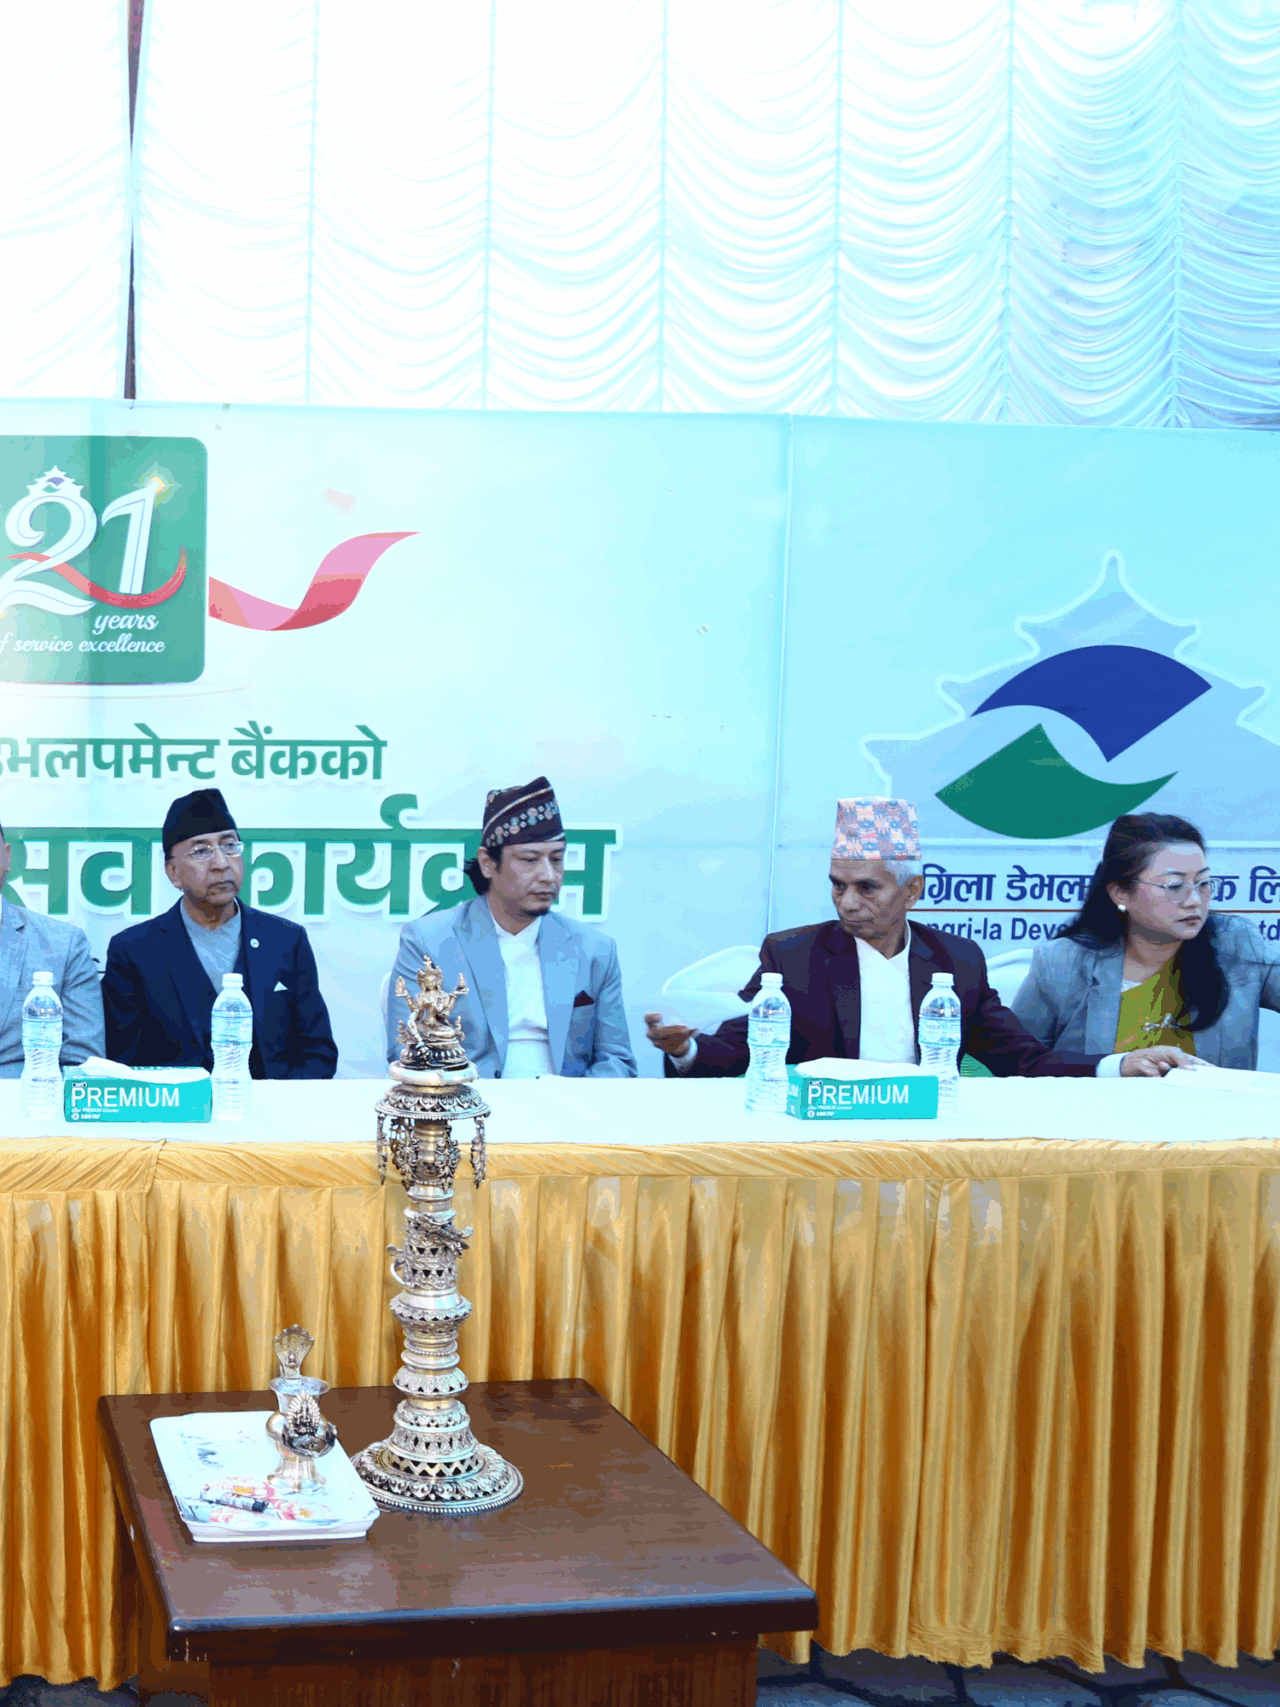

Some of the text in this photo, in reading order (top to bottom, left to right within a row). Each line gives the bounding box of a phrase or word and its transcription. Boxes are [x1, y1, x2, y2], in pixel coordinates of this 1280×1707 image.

[92, 613, 160, 635] years
[13, 635, 74, 653] service
[78, 633, 166, 653] excellence
[228, 720, 388, 780] बैंकको
[71, 1087, 180, 1107] PREMIUM
[807, 1084, 909, 1105] PREMIUM
